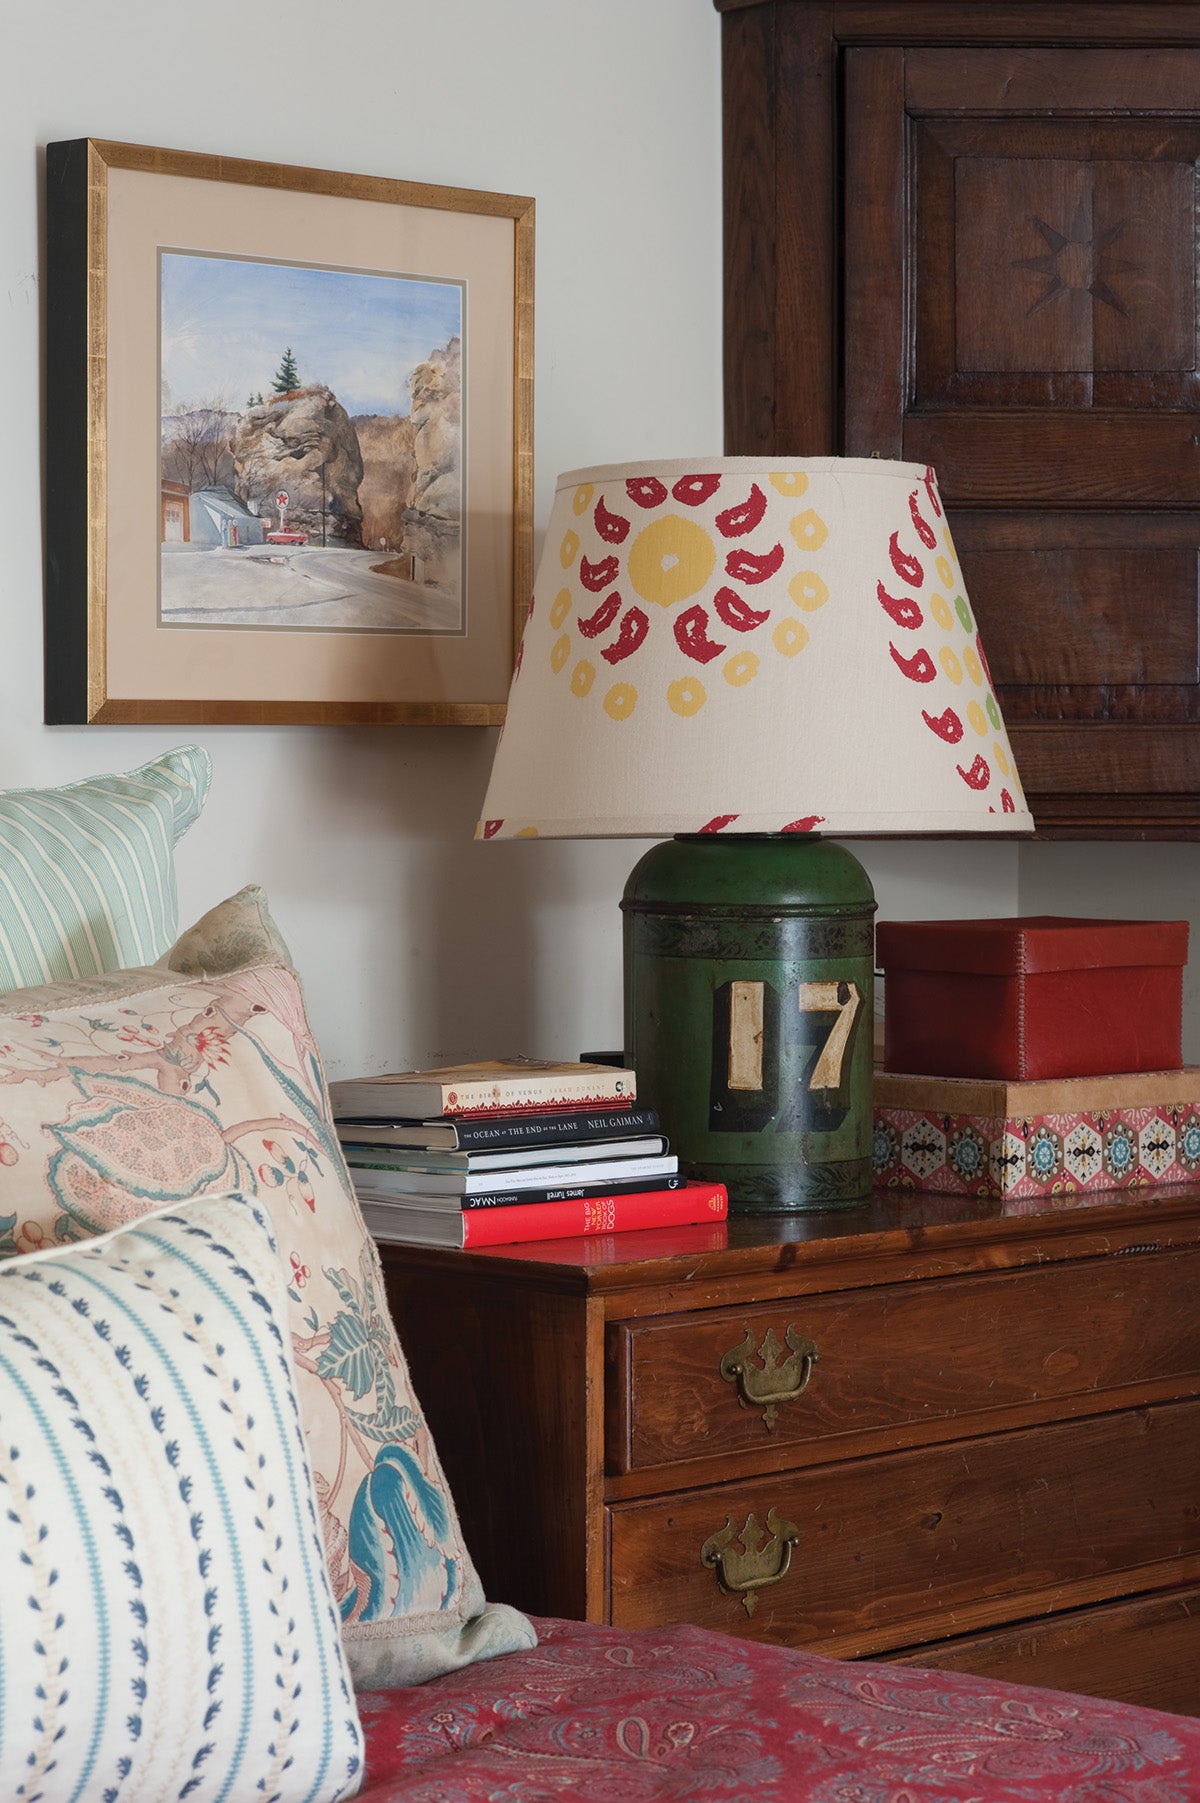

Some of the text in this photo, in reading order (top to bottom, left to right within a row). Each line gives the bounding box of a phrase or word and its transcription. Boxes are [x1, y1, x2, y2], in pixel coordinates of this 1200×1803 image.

[727, 979, 861, 1091] 17
[587, 1116, 643, 1129] NEIL GAIMAN
[473, 1129, 500, 1139] OCEAN
[508, 1127, 524, 1136] THE
[526, 1125, 542, 1134] END
[558, 1122, 578, 1131] LANE
[469, 1196, 496, 1207] NMAC
[547, 1189, 585, 1200] James Turrell
[583, 1202, 591, 1216] BIG
[606, 1199, 616, 1230] DOGS
